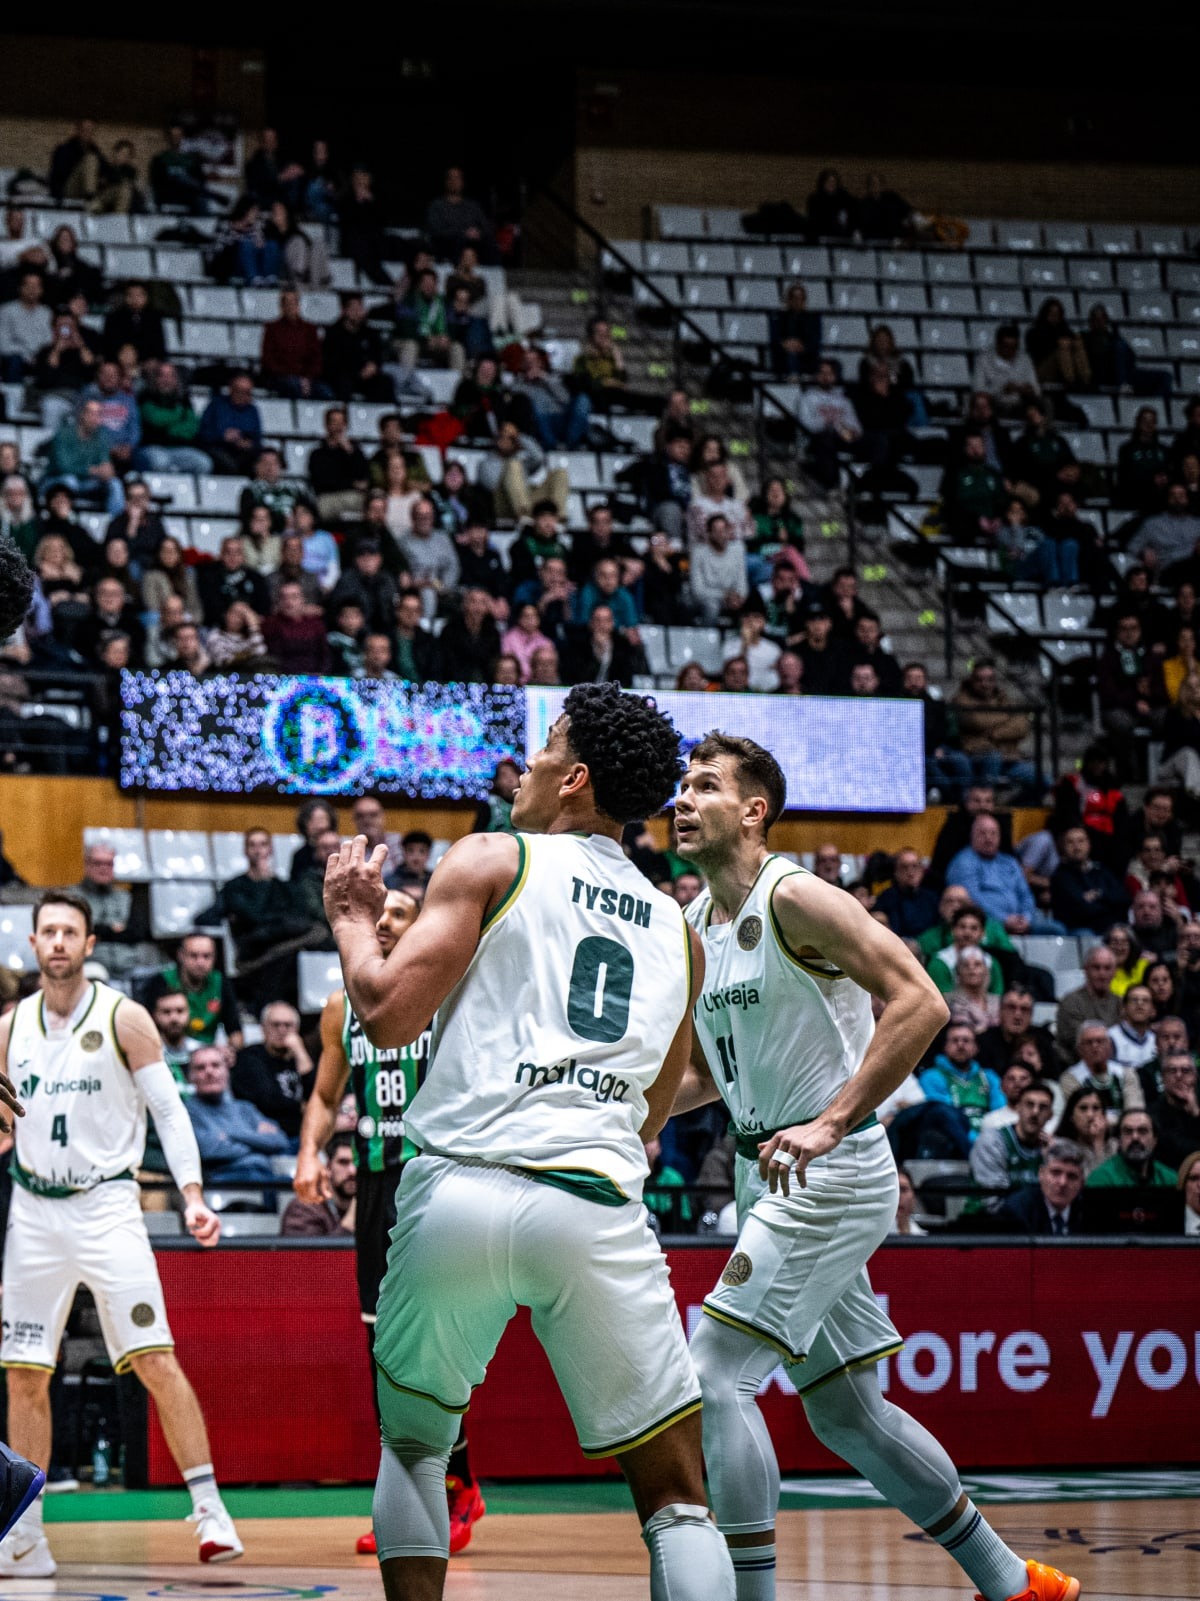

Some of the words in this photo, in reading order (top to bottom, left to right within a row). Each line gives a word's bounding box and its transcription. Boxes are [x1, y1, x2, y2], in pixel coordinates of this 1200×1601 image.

[572, 876, 652, 928] TYSON
[567, 935, 634, 1044] 0
[44, 1077, 102, 1095] Unicaja
[375, 1069, 407, 1107] 88
[51, 1114, 68, 1148] 4
[1081, 1329, 1200, 1419] yo
